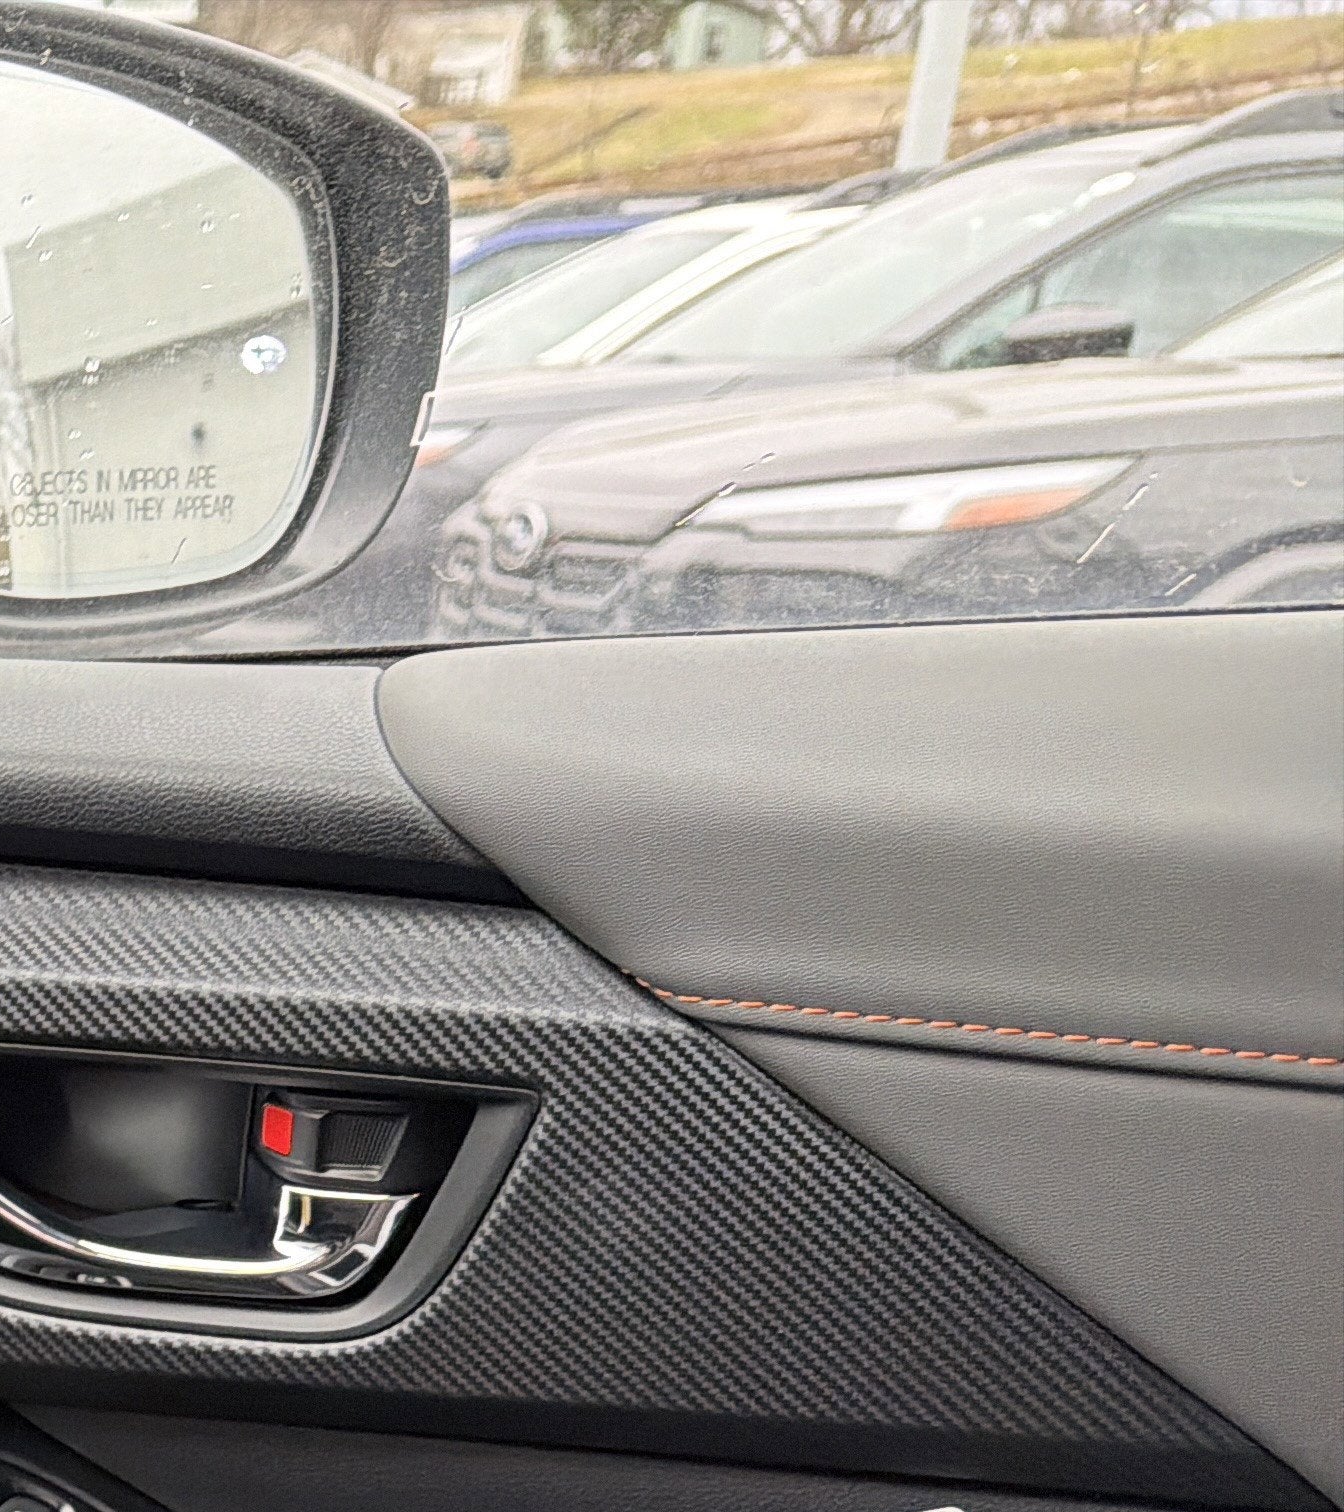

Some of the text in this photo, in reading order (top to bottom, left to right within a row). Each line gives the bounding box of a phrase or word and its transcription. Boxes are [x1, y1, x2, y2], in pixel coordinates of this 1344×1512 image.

[96, 468, 110, 493] IN
[117, 465, 179, 493] MIRROR
[185, 464, 216, 490] ARE
[69, 498, 114, 524] THAN
[124, 496, 165, 522] THEY
[174, 494, 234, 520] APPEAR
